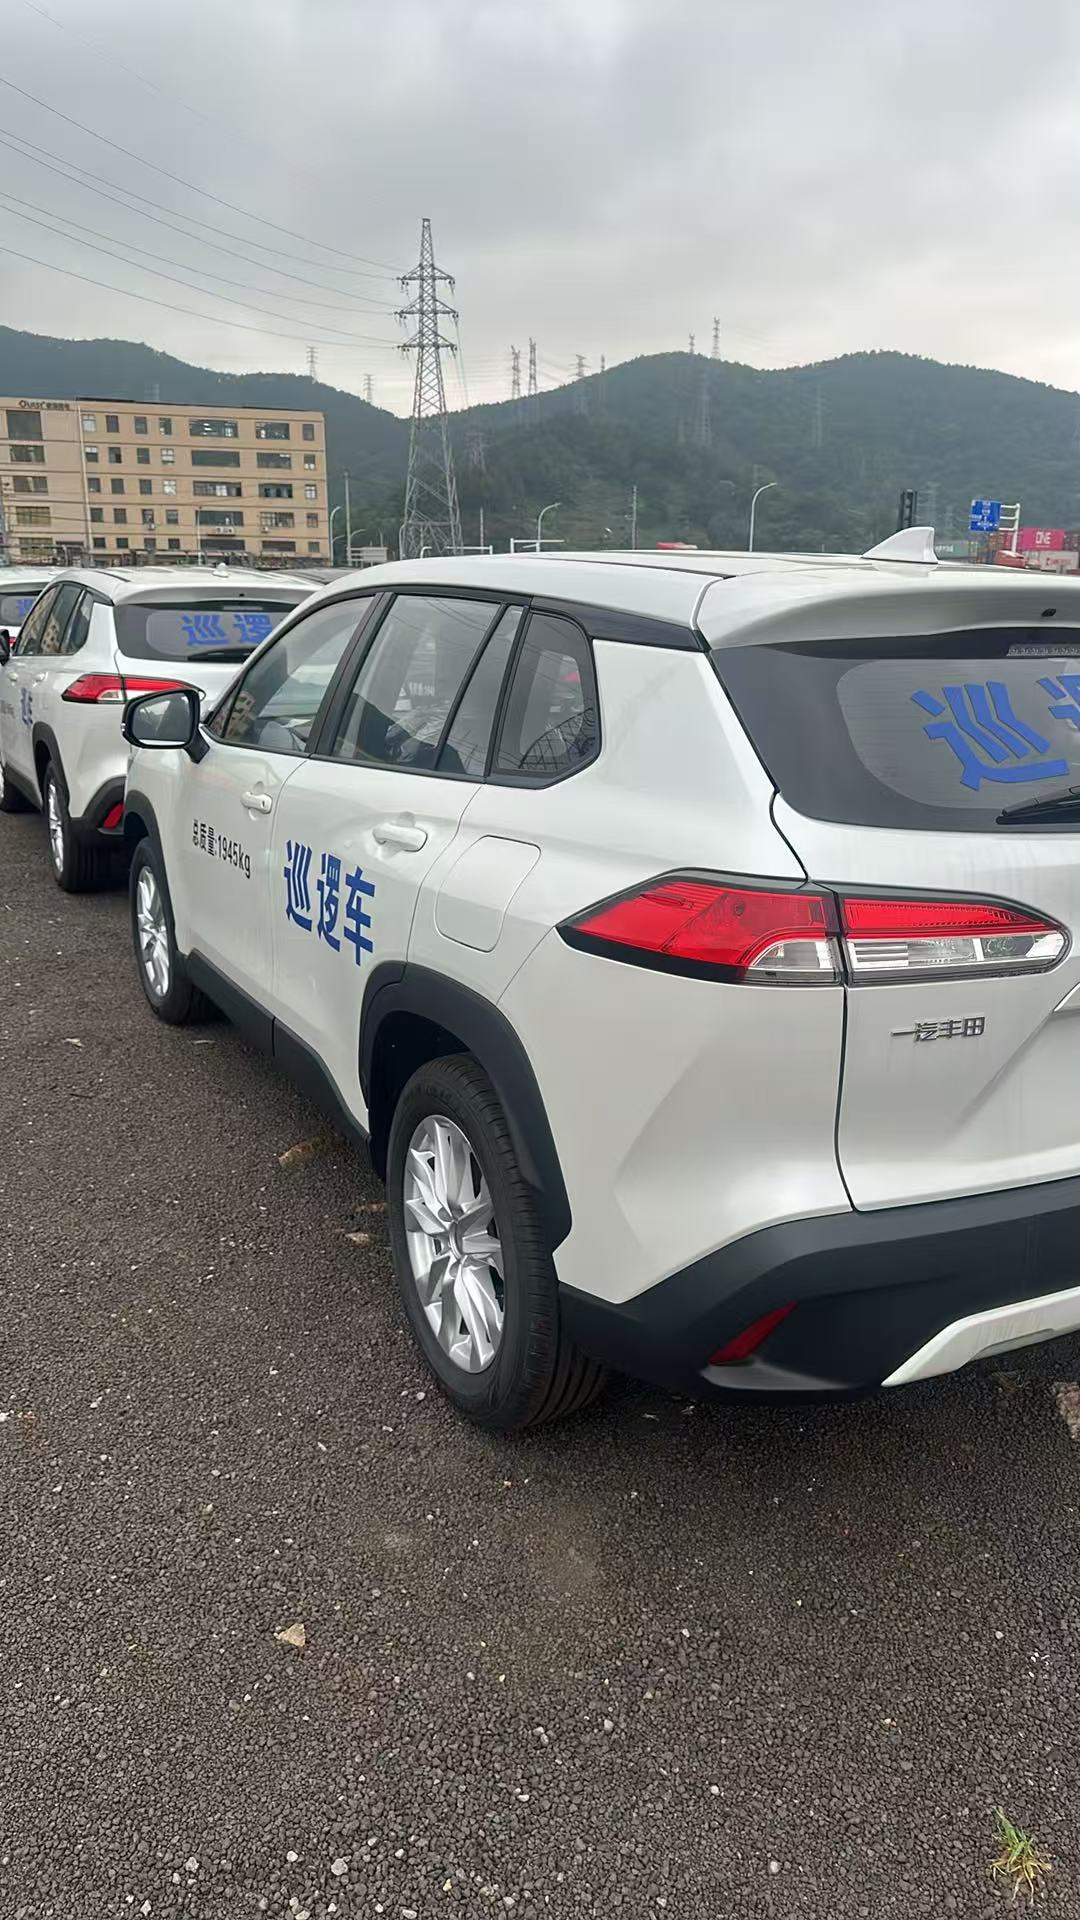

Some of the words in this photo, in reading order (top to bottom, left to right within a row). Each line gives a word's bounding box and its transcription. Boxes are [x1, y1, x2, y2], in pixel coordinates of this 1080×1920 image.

[1035, 531, 1051, 545] ONE
[910, 674, 1080, 792] 巡
[283, 839, 376, 967] 巡逻车
[891, 1015, 986, 1042] 一汽丰田
